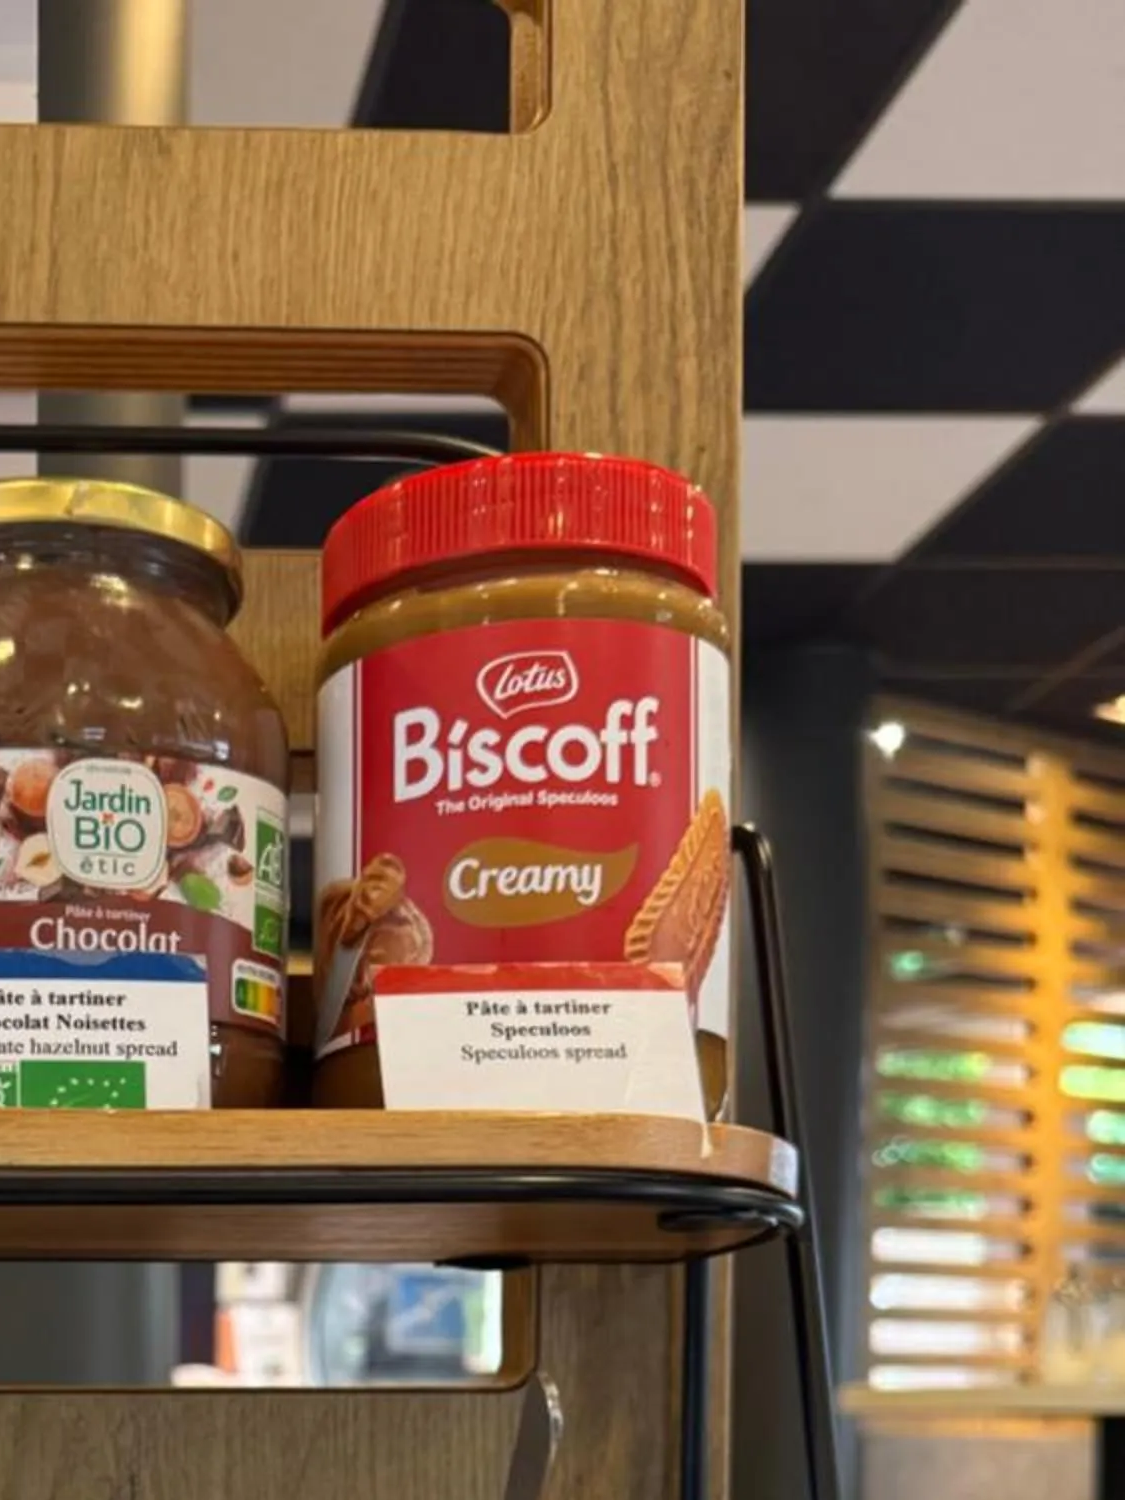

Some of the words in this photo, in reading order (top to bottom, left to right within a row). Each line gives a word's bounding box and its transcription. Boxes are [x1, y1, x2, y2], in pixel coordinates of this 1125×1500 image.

[493, 661, 566, 700] Lotus
[393, 697, 660, 803] Biscoff
[64, 779, 152, 815] Jardin
[435, 799, 466, 816] The
[468, 791, 534, 813] Original
[536, 790, 619, 808] Speculoos
[448, 857, 603, 906] Creamy
[31, 988, 43, 1006] à
[48, 989, 127, 1007] tartiner
[465, 999, 511, 1017] Pâte
[516, 998, 528, 1015] à
[533, 999, 613, 1016] tartiner
[56, 1013, 147, 1032] Noisettes
[490, 1021, 592, 1041] Speculoos
[29, 1037, 111, 1056] hazelnut
[114, 1039, 178, 1060] spread
[460, 1043, 561, 1065] Speculoos
[564, 1043, 628, 1064] spread
